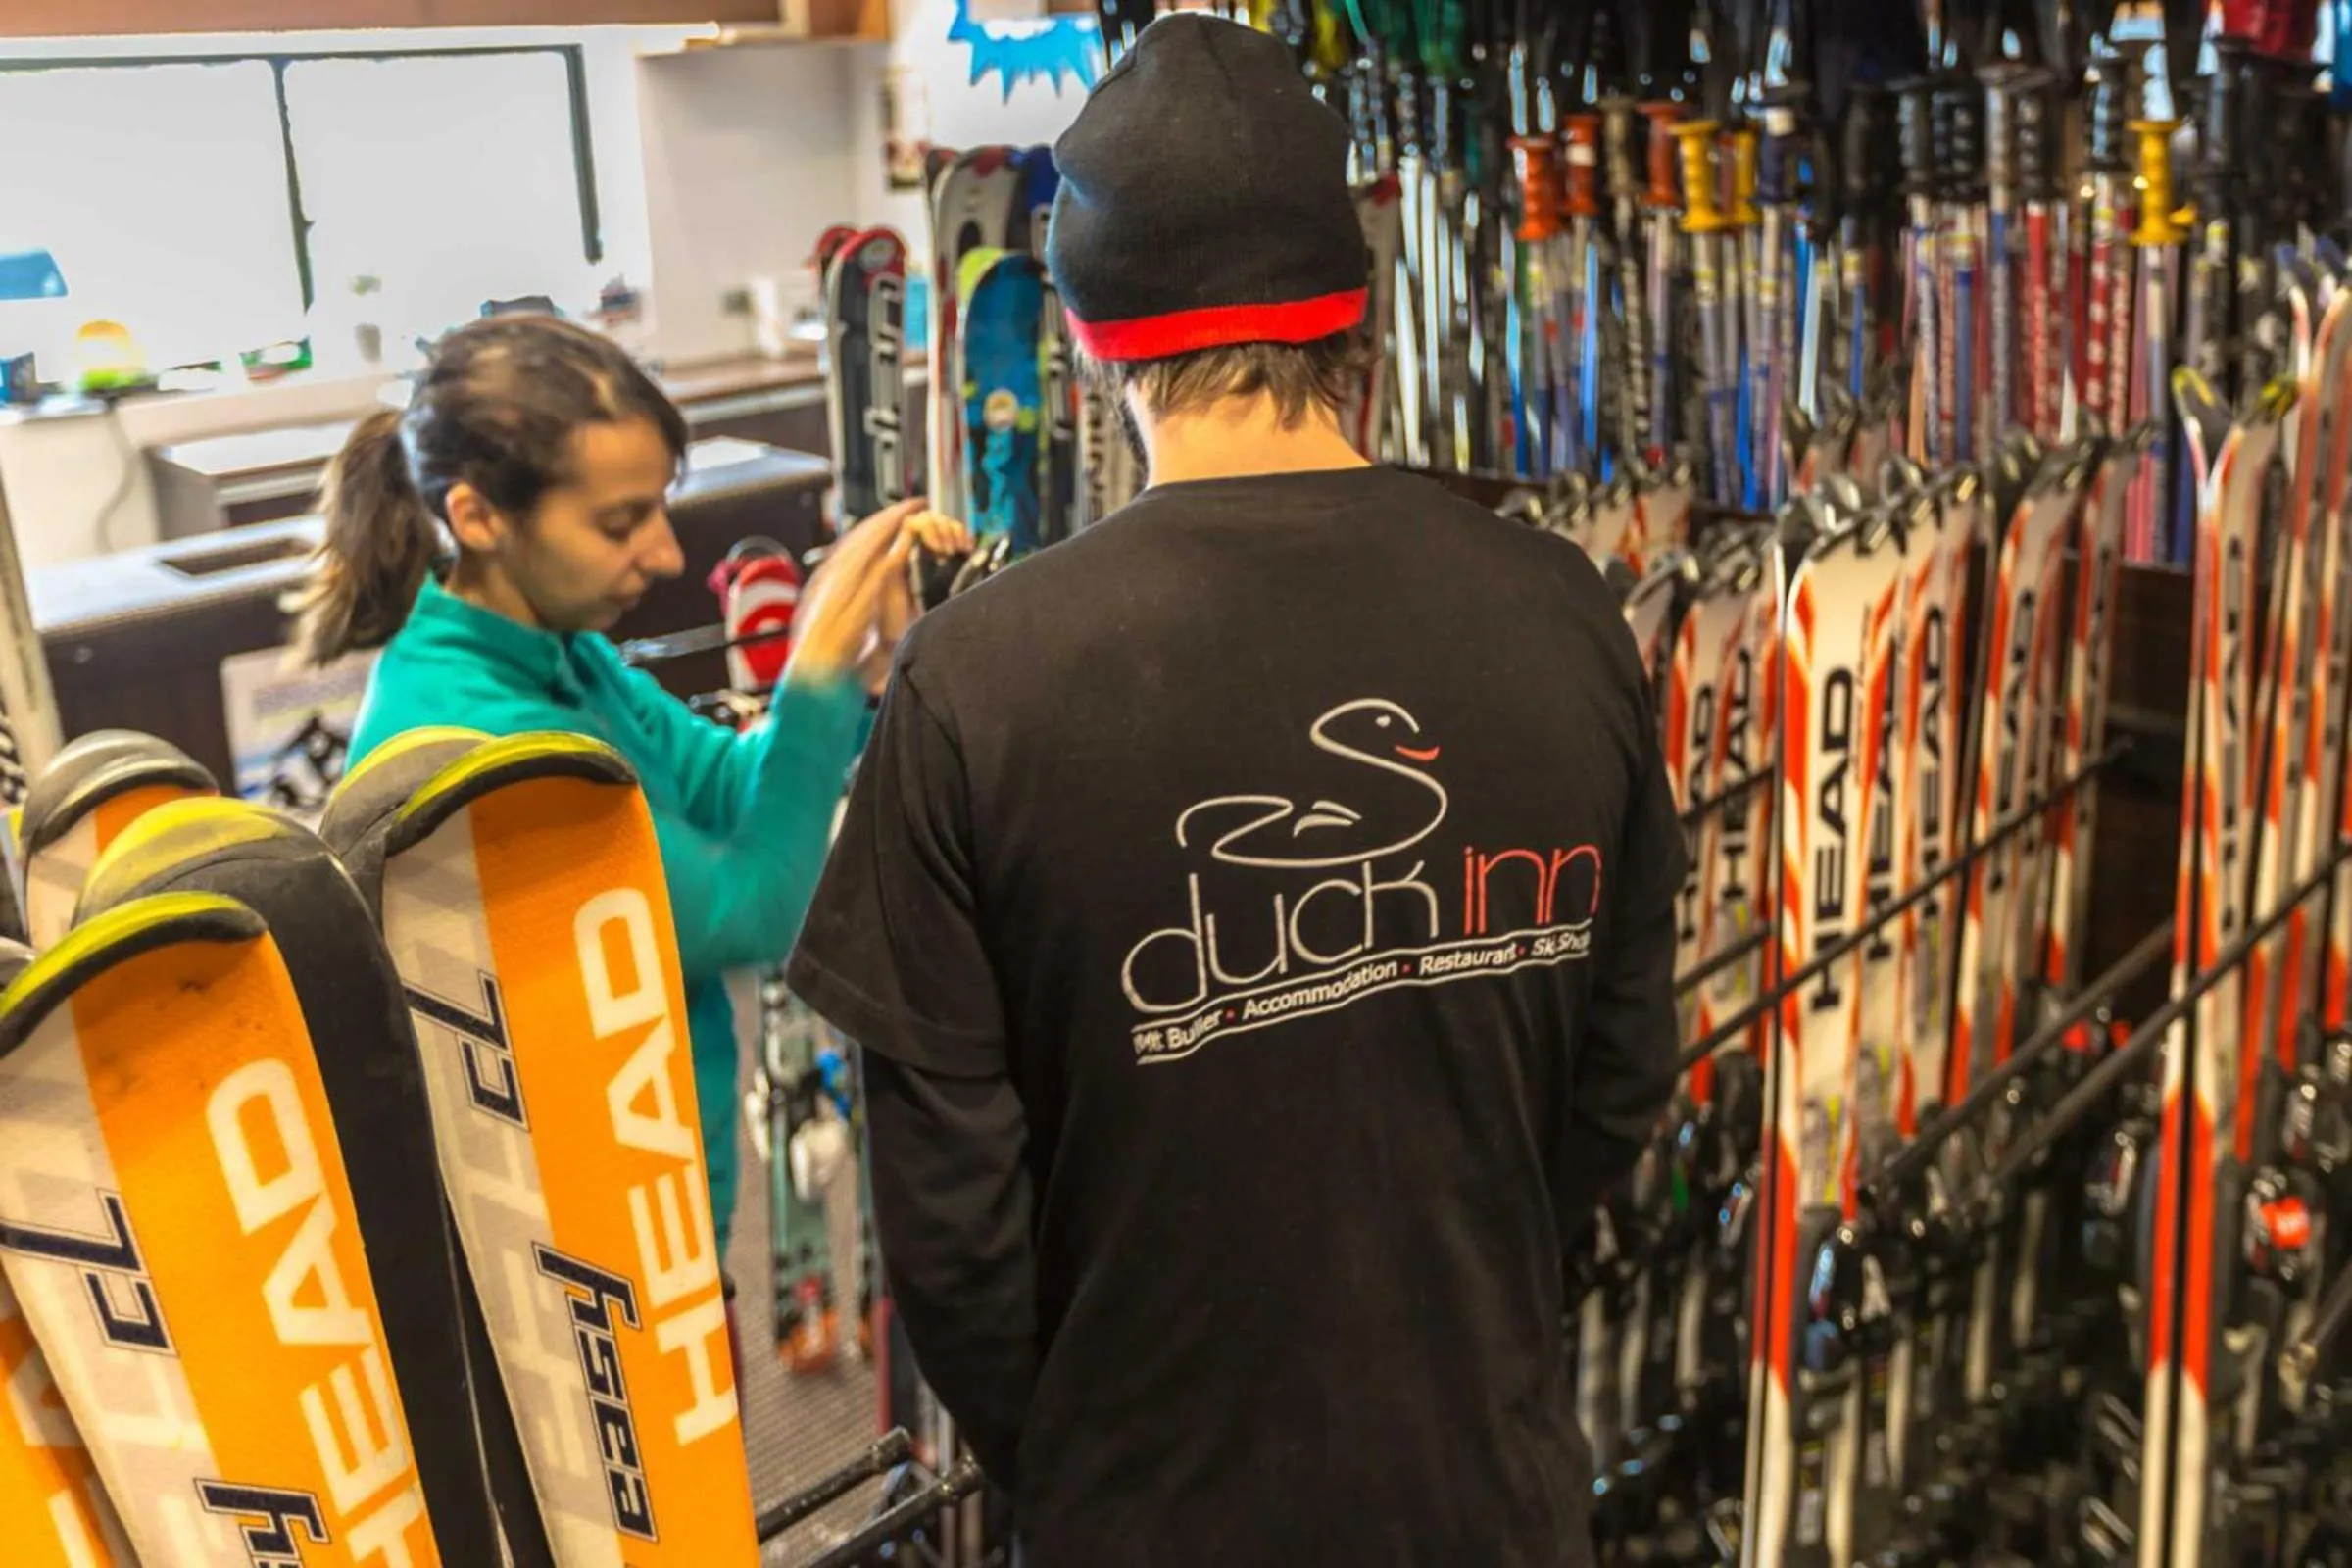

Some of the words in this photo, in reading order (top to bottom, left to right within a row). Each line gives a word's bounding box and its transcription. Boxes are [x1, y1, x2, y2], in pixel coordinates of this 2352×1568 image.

[1122, 860, 1438, 1012] duck
[1464, 844, 1601, 934] inn
[1810, 666, 1853, 1011] HEAD
[1869, 639, 1895, 961] HEA
[1133, 1029, 1164, 1055] Mt
[1166, 1009, 1223, 1049] Buller
[1242, 961, 1398, 1020] Accommodation
[1530, 935, 1555, 956] Sk
[573, 886, 739, 1446] HEAD
[532, 1241, 659, 1543] easy
